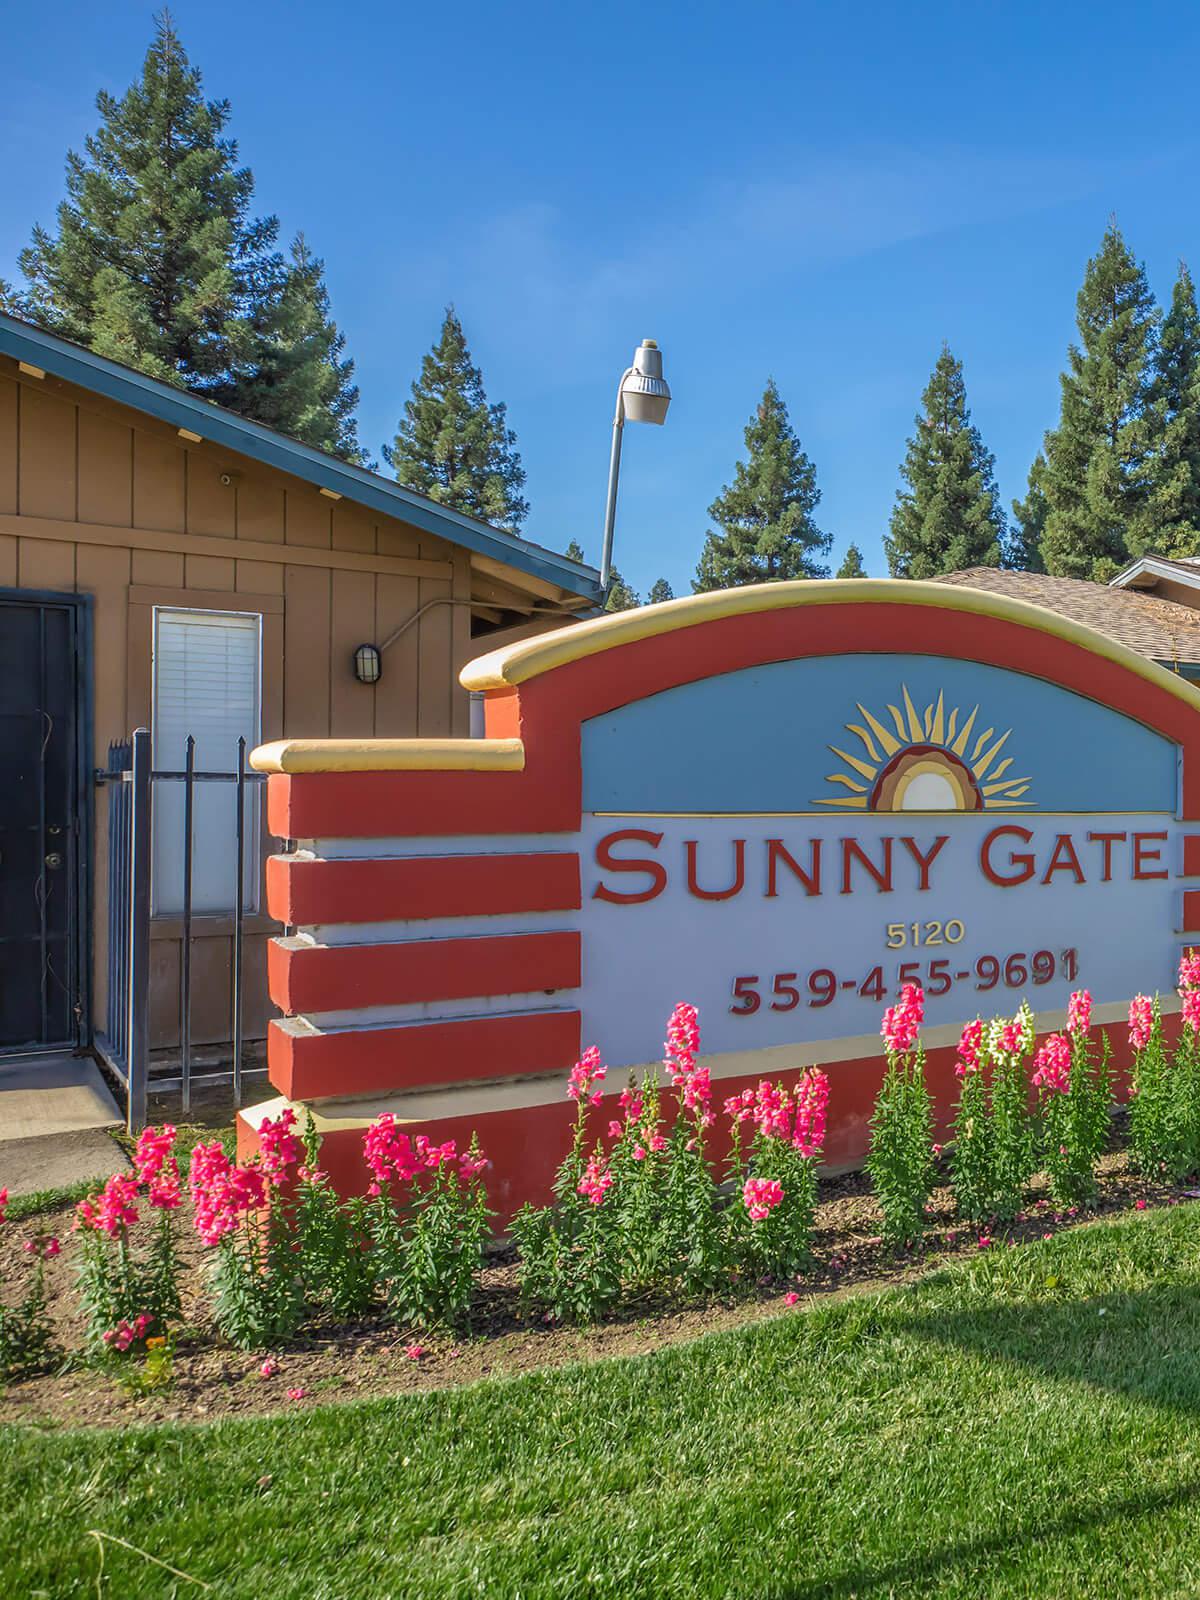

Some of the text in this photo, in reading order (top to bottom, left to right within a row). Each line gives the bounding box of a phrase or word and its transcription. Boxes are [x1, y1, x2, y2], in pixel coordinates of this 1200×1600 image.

[592, 825, 1170, 906] SUNNY GATE
[887, 919, 966, 949] 5120
[729, 948, 1079, 1016] 559-455-9691
